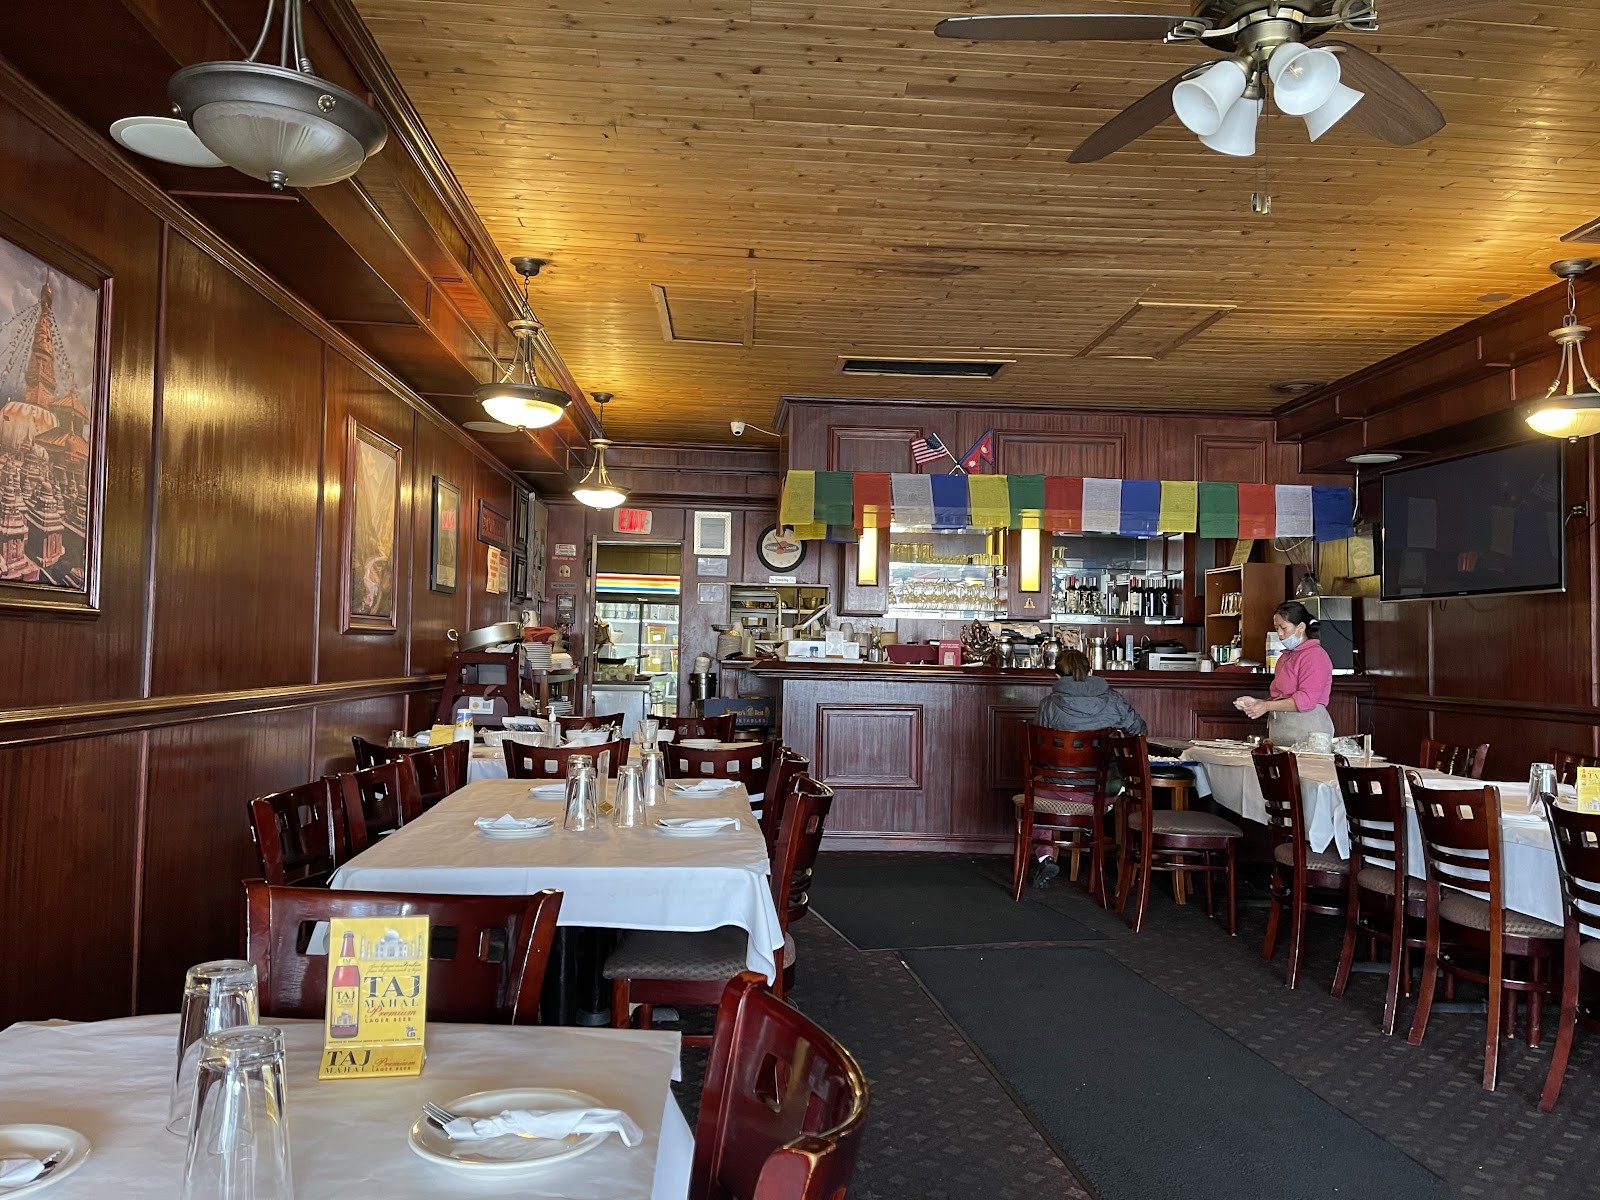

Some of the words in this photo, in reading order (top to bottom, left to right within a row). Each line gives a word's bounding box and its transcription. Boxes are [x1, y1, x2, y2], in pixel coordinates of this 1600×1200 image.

[618, 509, 646, 532] EXIT
[363, 975, 421, 998] TAJ
[336, 991, 355, 1000] TAJ
[364, 999, 419, 1008] MAHAL
[366, 1006, 417, 1018] Premium
[327, 1050, 371, 1066] TAJ
[374, 1058, 416, 1067] Premium
[325, 1066, 367, 1074] MAHAL
